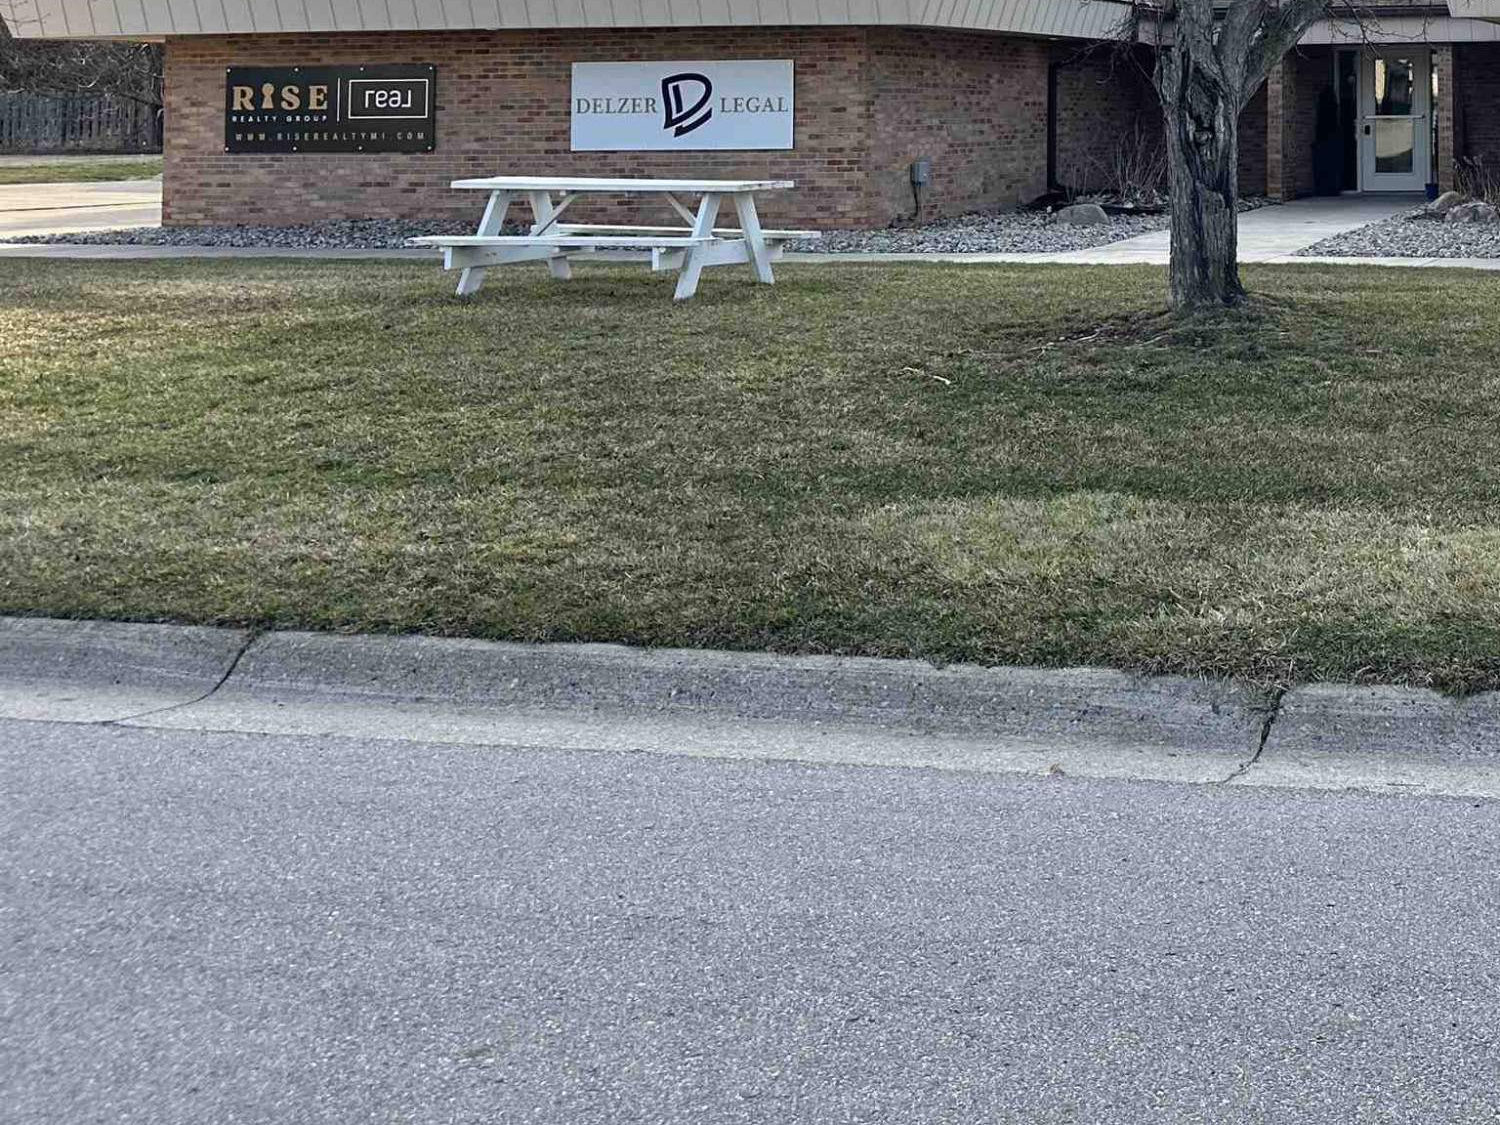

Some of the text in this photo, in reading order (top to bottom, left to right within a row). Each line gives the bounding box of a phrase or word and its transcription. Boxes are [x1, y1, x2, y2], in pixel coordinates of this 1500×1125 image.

[232, 83, 328, 111] RISE
[364, 89, 412, 109] real
[576, 97, 657, 115] DELZER
[720, 96, 789, 114] LEGAL
[231, 115, 328, 123] REALTY GROUP
[235, 131, 425, 142] WWW.RISEREALTYMI.COM
